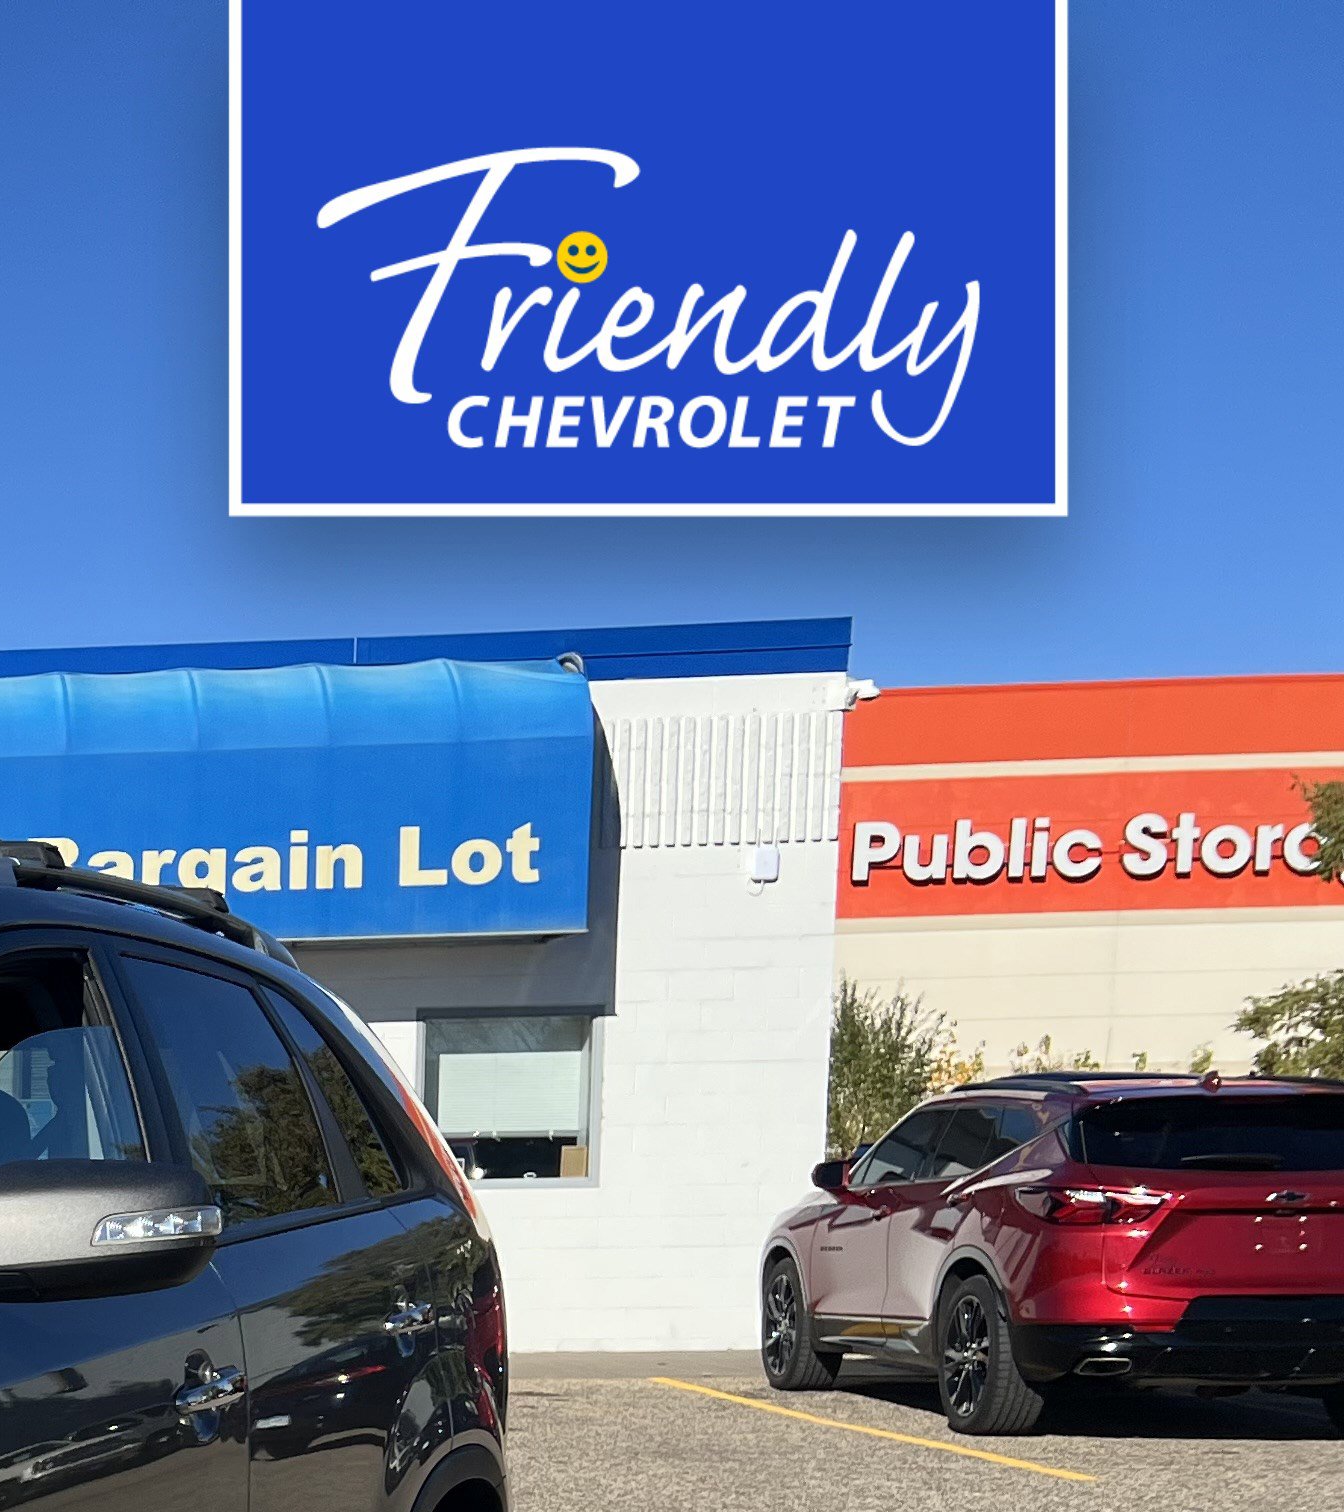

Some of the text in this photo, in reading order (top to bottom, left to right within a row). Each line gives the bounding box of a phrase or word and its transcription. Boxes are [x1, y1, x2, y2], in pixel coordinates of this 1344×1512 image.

[27, 829, 363, 898] argain
[399, 822, 542, 888] Lot
[852, 812, 1344, 888] Public Stora
